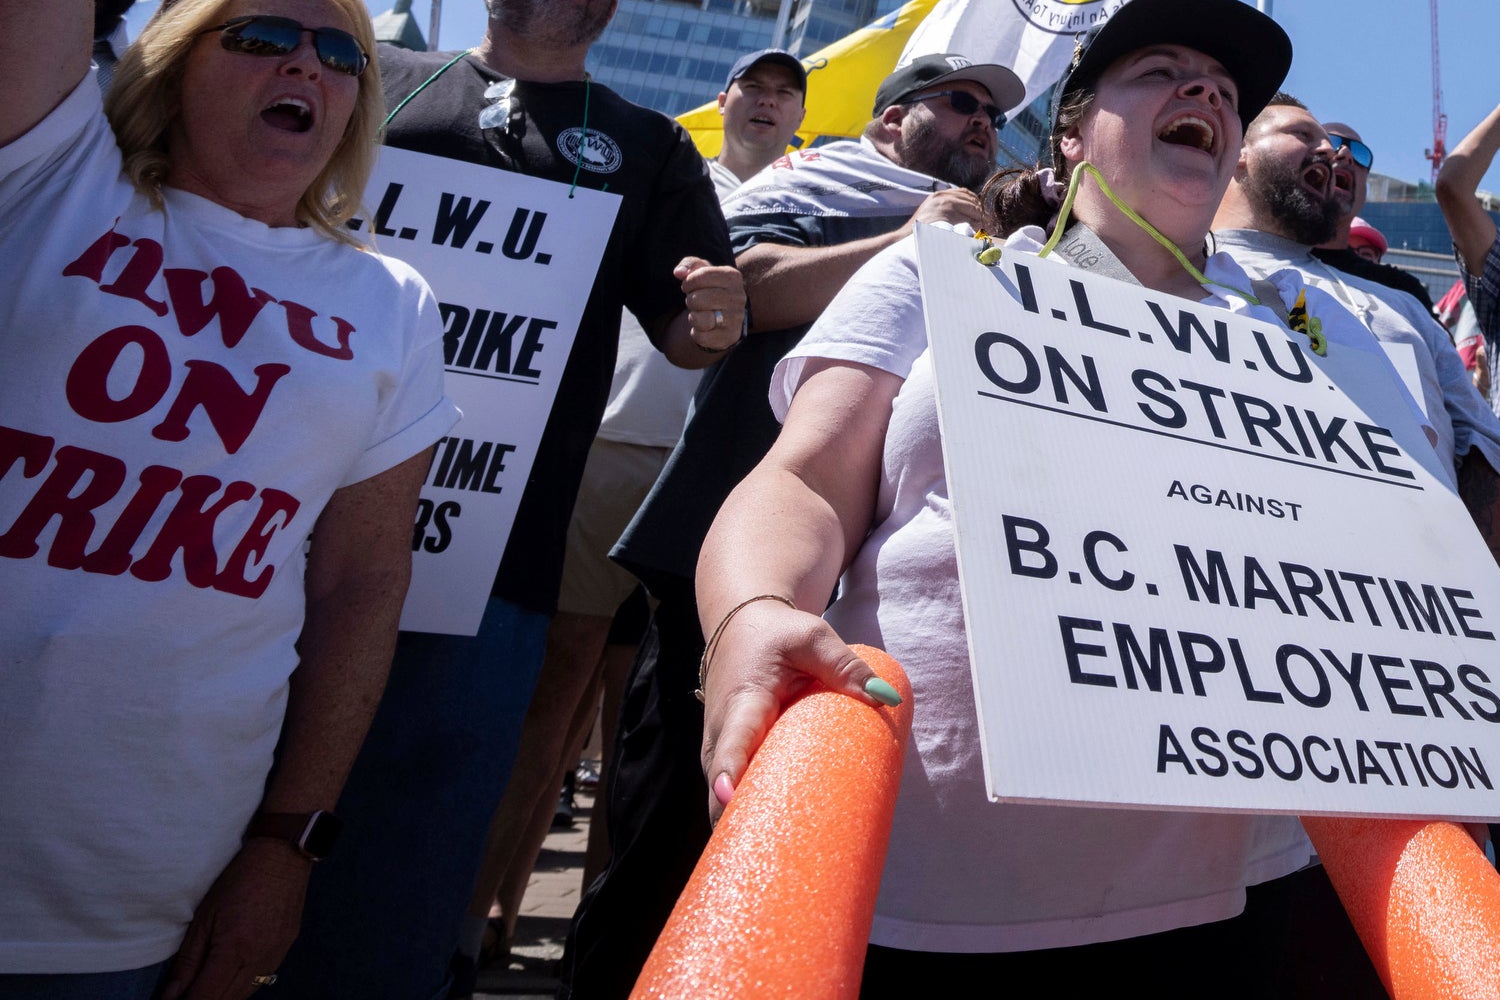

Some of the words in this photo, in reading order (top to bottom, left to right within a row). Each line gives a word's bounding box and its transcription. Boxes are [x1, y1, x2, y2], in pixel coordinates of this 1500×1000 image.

[347, 182, 553, 266] .L.W.U.
[438, 302, 558, 379] RIKE
[1013, 262, 1336, 391] I.L.W.U.
[66, 325, 291, 455] ON
[974, 331, 1108, 414] ON
[1131, 368, 1417, 481] STRIKE
[0, 425, 301, 600] TRIKE
[422, 436, 517, 494] TIME
[1167, 480, 1302, 522] AGAINST
[1002, 514, 1161, 596] B.C.
[1173, 543, 1496, 641] MARITIME
[1156, 724, 1494, 791] ASSOCIATION
